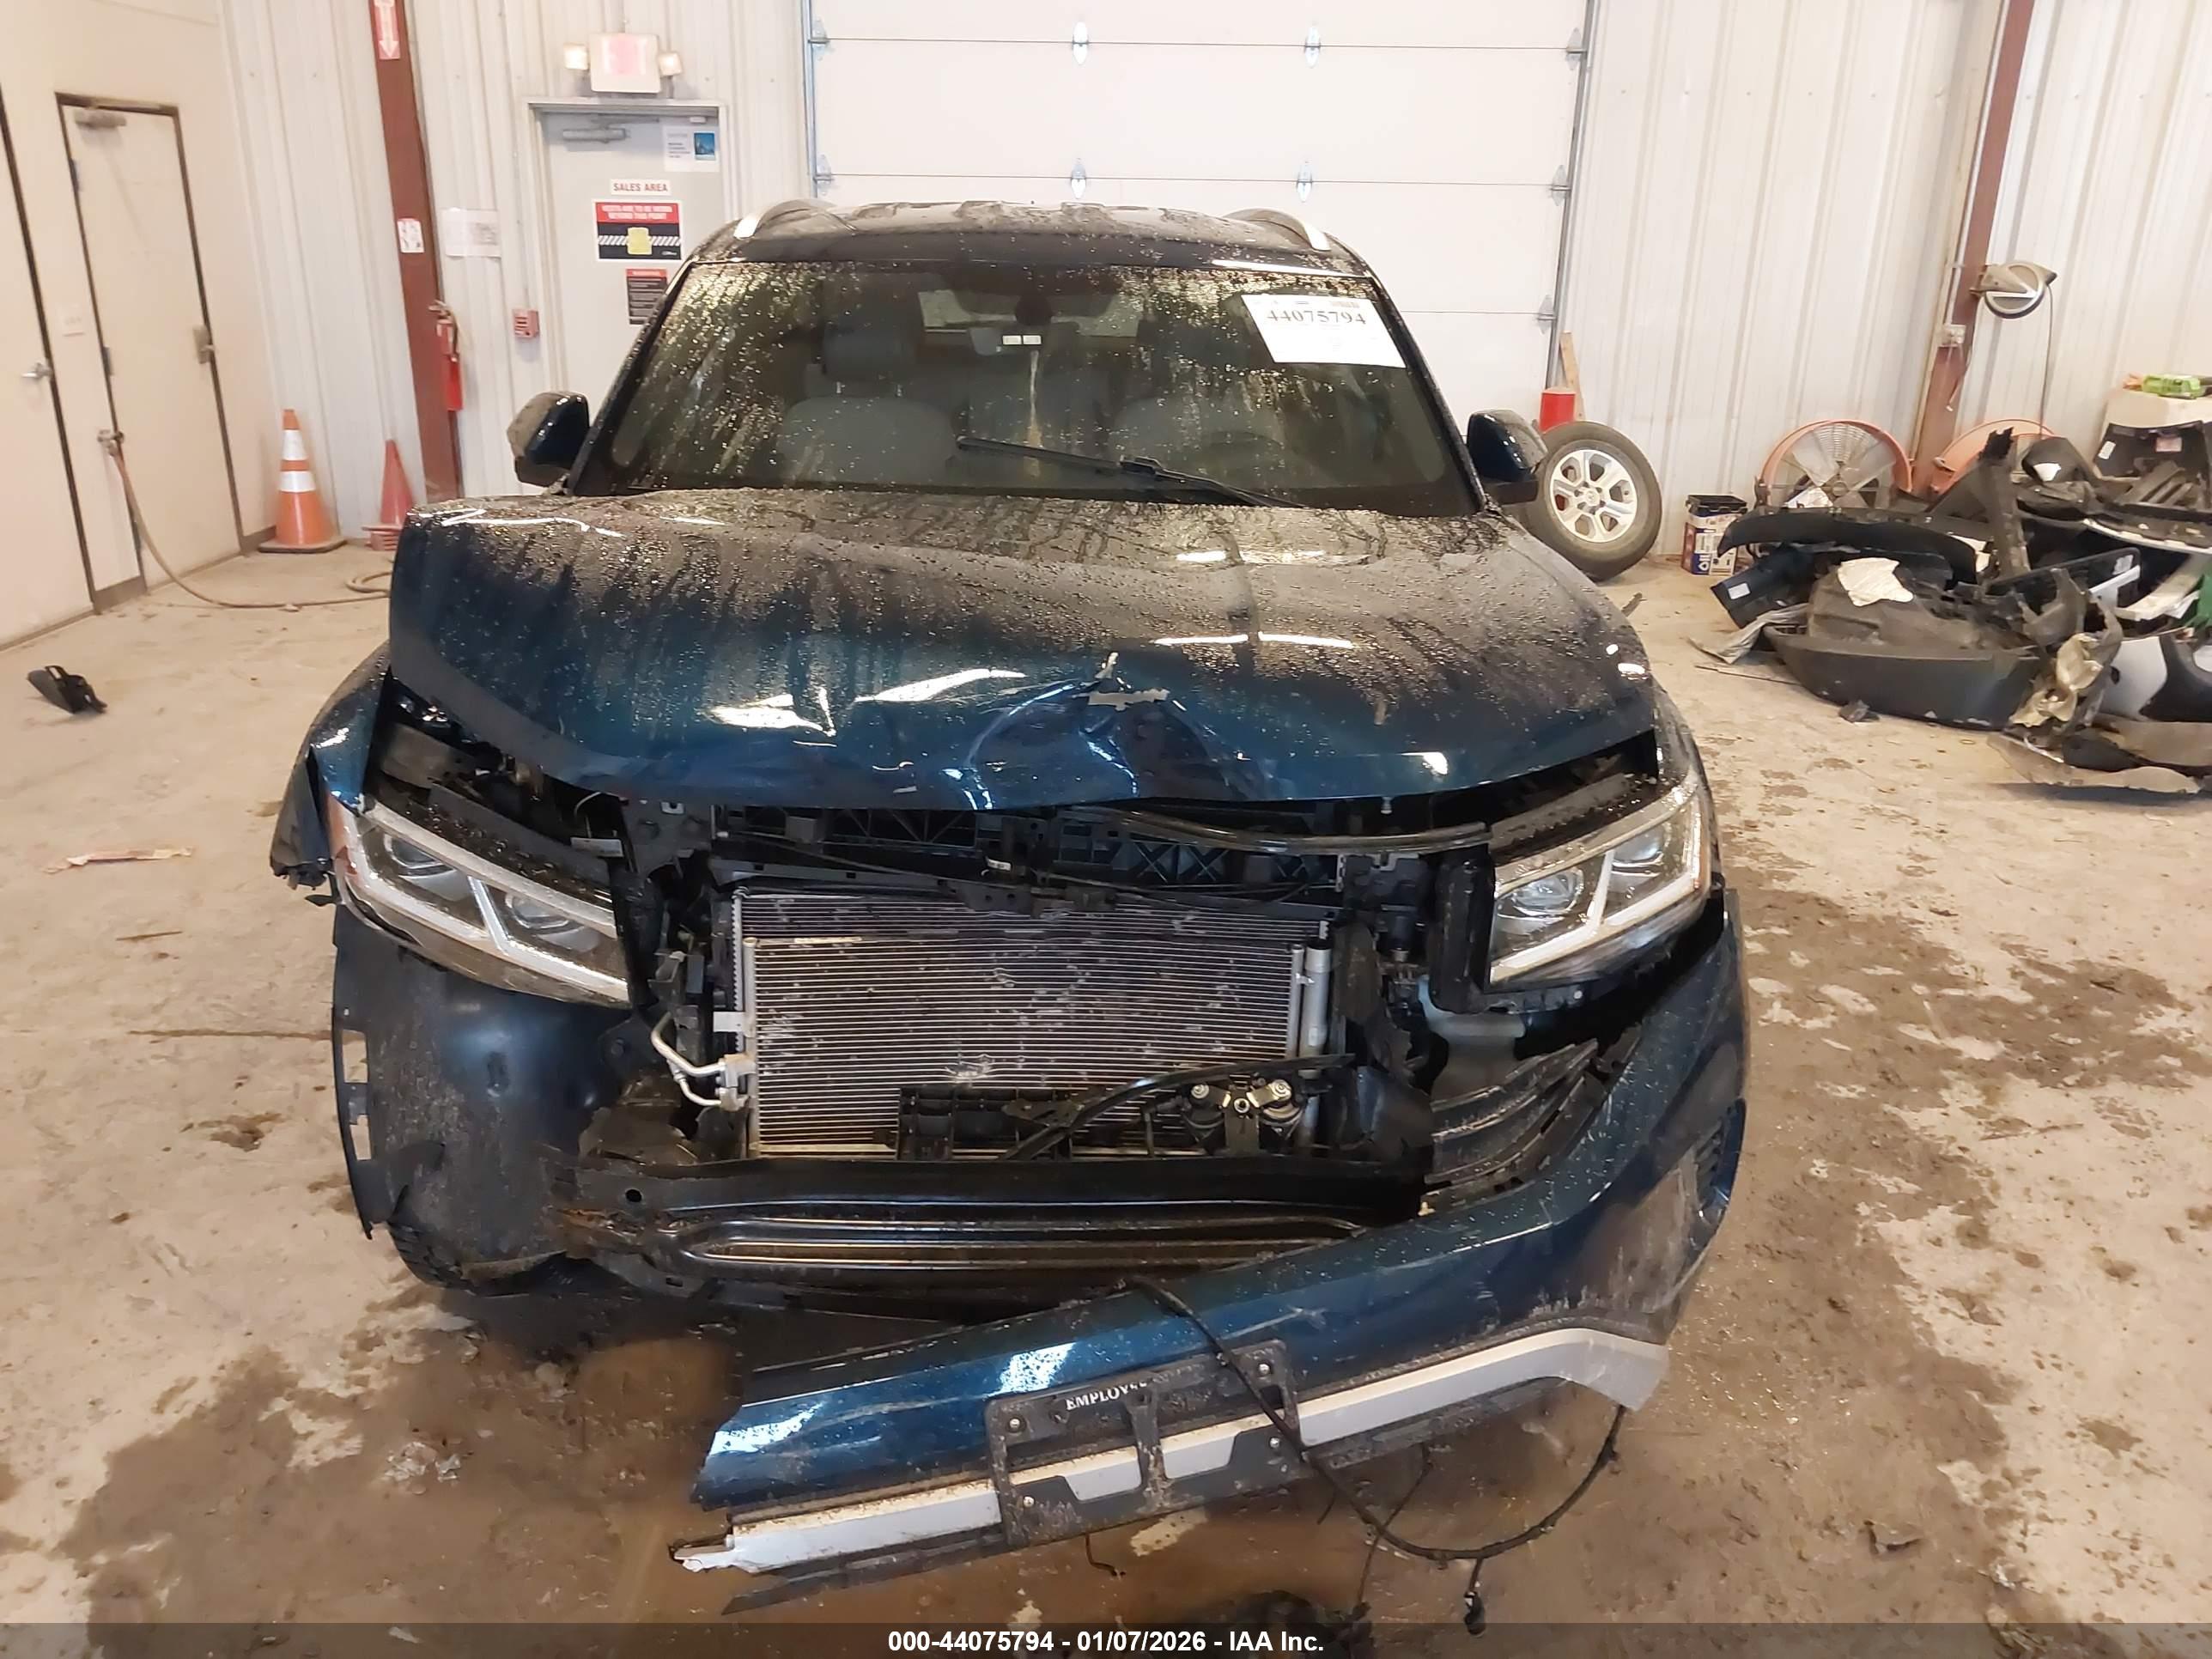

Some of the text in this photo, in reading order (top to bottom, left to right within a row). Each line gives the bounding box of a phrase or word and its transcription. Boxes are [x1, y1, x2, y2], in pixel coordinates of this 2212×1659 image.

[613, 183, 668, 192] SALES AREA
[1267, 310, 1366, 324] 44075794
